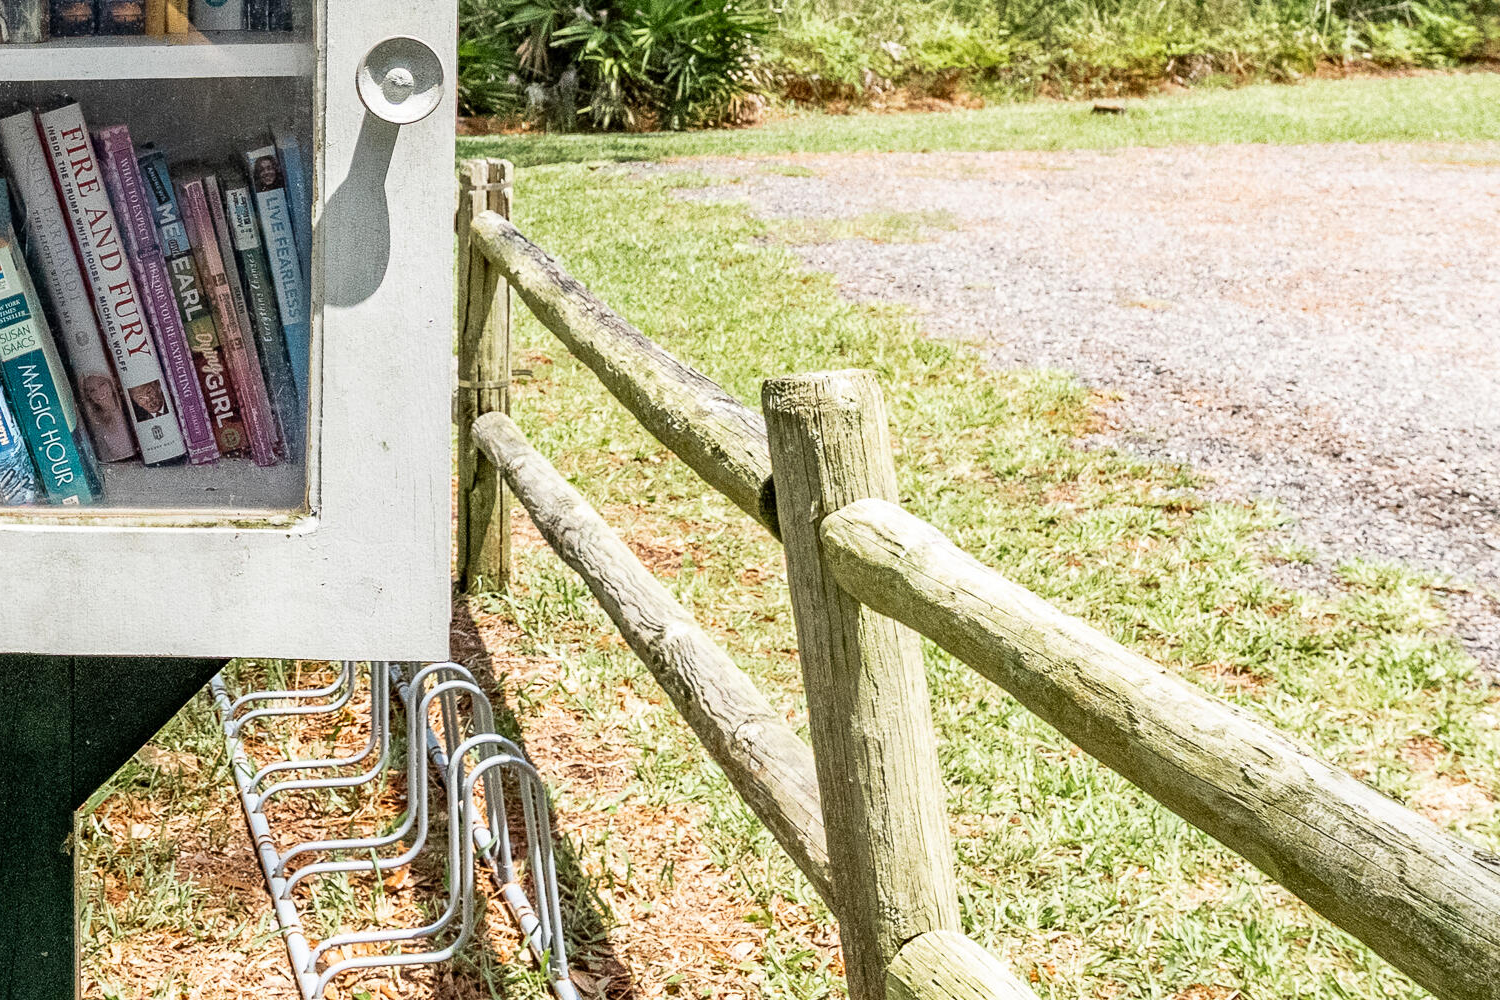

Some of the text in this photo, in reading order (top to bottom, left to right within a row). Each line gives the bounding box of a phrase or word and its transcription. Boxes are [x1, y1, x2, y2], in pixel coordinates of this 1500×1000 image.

[47, 125, 100, 282] INSIDE THE TRUMP WHITE HOUSE
[120, 158, 149, 241] WHAT TO EXPECT
[147, 167, 167, 201] ANDREWS
[60, 123, 152, 357] FIRE AND FURY
[156, 203, 181, 240] ME
[266, 197, 285, 233] LIVE
[33, 210, 71, 325] THE LIGHT WITHIN ME
[171, 256, 202, 322] EARL
[247, 253, 260, 290] Changes
[275, 238, 301, 318] FEARLESS
[0, 308, 17, 318] TIMES
[6, 299, 21, 310] YORK
[148, 262, 166, 301] BEFORE
[160, 301, 177, 338] YOU'RE
[170, 341, 192, 398] EXPECTING
[257, 292, 273, 342] Everything
[2, 335, 36, 356] ISAACS
[99, 295, 127, 372] MICHAEL WOLFF
[192, 332, 224, 377] Dying
[18, 364, 74, 487] MAGIC HOUR
[205, 374, 234, 429] GIRL
